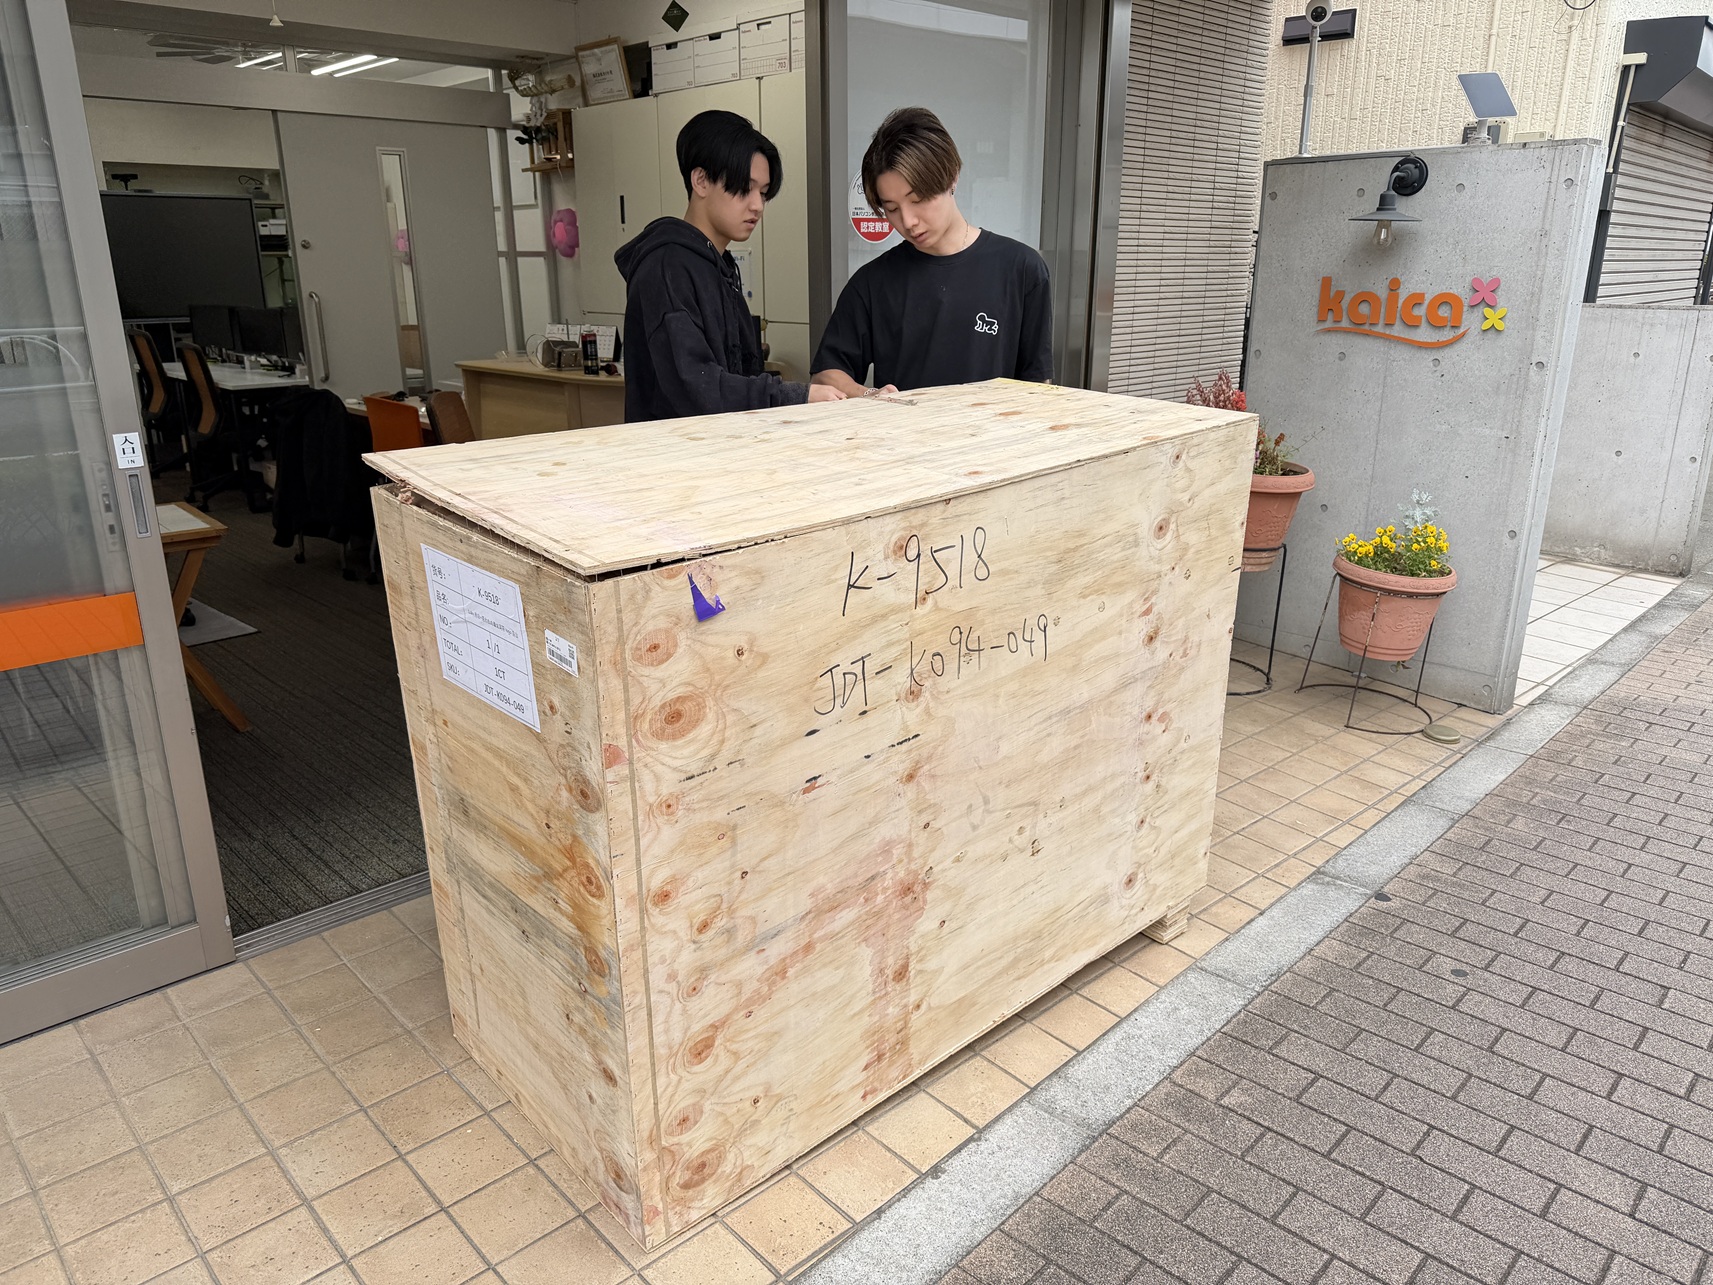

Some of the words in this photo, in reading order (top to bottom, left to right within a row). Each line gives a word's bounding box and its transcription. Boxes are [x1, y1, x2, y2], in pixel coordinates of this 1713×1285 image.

[860, 221, 890, 233] 認定教室
[1317, 277, 1463, 327] kaica
[121, 436, 135, 455] 入口
[842, 526, 990, 616] K-9518
[477, 587, 500, 606] K-9518
[443, 637, 463, 656] TOTAL:
[446, 661, 460, 676] SKU:
[494, 667, 506, 680] 1CT
